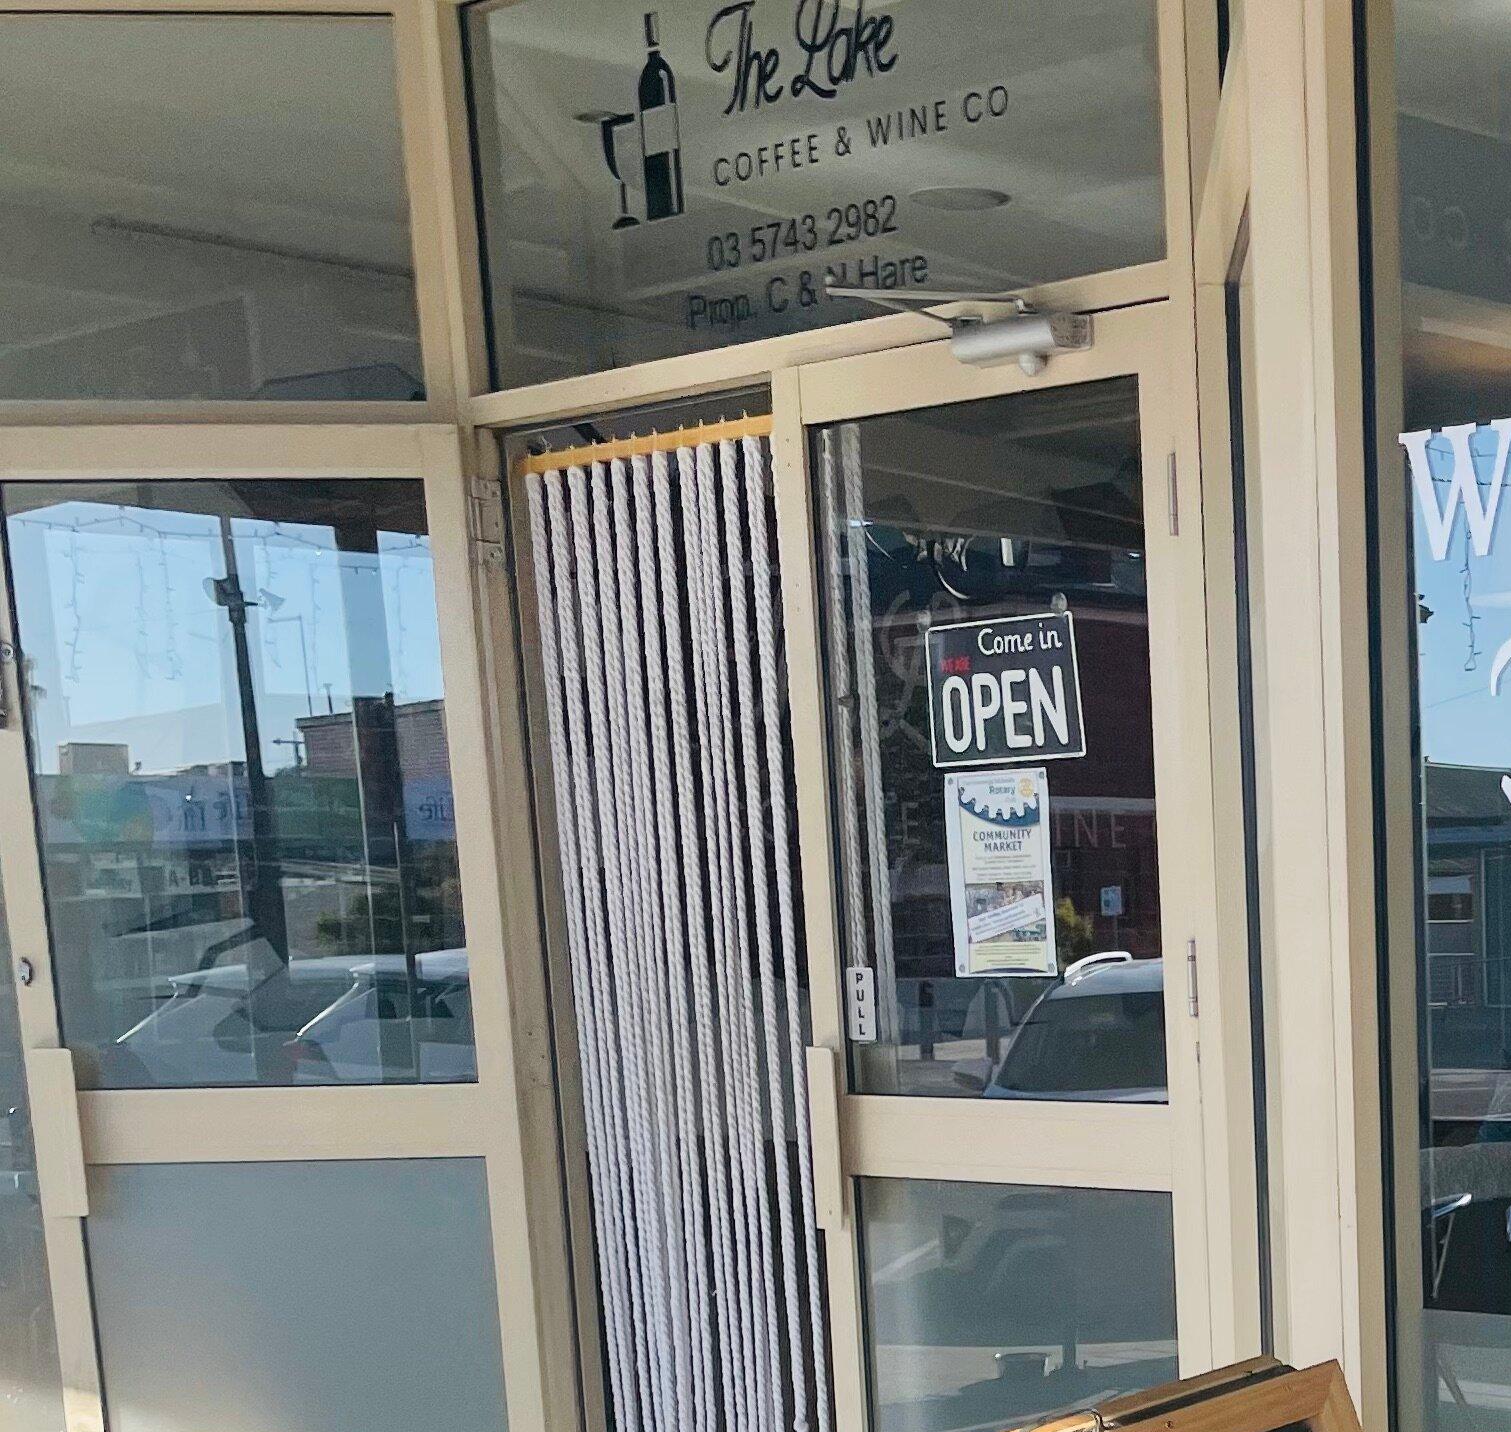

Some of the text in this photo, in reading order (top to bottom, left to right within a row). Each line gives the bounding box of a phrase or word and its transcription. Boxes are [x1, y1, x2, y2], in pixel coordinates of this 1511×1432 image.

[704, 0, 899, 115] The Lake
[712, 85, 1009, 187] COFFEE & WINE CO
[706, 194, 899, 272] 03 5743 2982
[764, 276, 790, 314] C
[799, 271, 818, 308] &
[859, 255, 929, 290] Hare
[977, 622, 1063, 656] Come in
[942, 665, 1070, 753] OPEN
[988, 785, 1016, 796] Rotary
[972, 828, 1032, 842] COMMUNITY
[983, 840, 1023, 853] MARKET
[855, 972, 867, 1036] PULL
